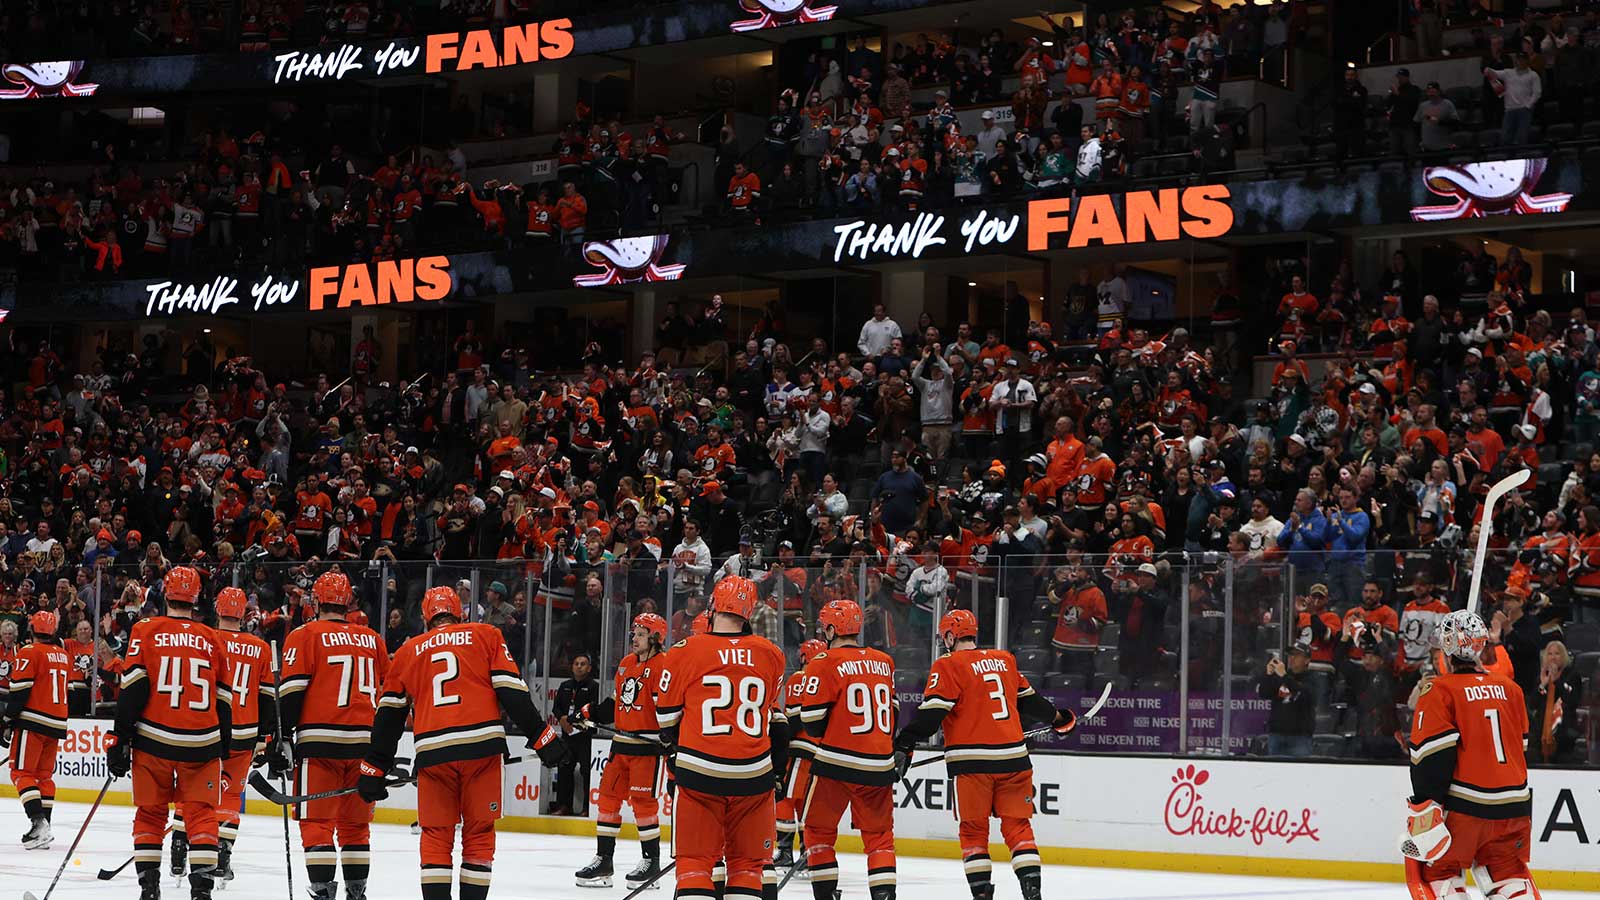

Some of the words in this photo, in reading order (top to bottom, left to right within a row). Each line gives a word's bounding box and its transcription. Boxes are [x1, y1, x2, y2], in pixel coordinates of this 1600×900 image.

[275, 44, 363, 83] THANK
[375, 43, 420, 75] YOU
[426, 19, 574, 73] FANS
[995, 110, 1012, 120] 319
[834, 212, 946, 262] THANK
[961, 210, 1019, 252] YOU
[1028, 185, 1234, 250] FANS
[146, 276, 238, 316] THANK
[252, 276, 298, 310] YOU
[310, 256, 452, 310] FANS
[226, 640, 262, 659] NSTON
[321, 632, 377, 650] CARLSON
[415, 631, 473, 656] LACOMBE
[15, 658, 29, 671] 17
[283, 648, 297, 667] 4
[718, 648, 755, 667] VIEL
[971, 659, 1008, 675] MOORE
[49, 669, 68, 704] 17
[157, 656, 211, 711] 45
[327, 655, 377, 709] 74
[431, 651, 461, 707] 2
[928, 672, 940, 690] 3
[983, 673, 1010, 720] 3
[1464, 685, 1508, 702] DOSTAL
[701, 675, 767, 738] 28
[847, 683, 891, 735] 98
[1137, 699, 1161, 709] TIRE
[1207, 699, 1244, 710] NEEN
[1248, 700, 1272, 710] TIRE
[1152, 718, 1181, 728] NEXE
[1191, 718, 1216, 728] TIRE
[1417, 711, 1425, 731] 1
[1098, 735, 1133, 746] NEXEN
[1137, 736, 1161, 746] TIRE
[1206, 737, 1245, 748] NEEN
[1484, 708, 1507, 764] 1
[53, 755, 109, 778] isabili
[1164, 781, 1321, 846] Chick-fil-A
